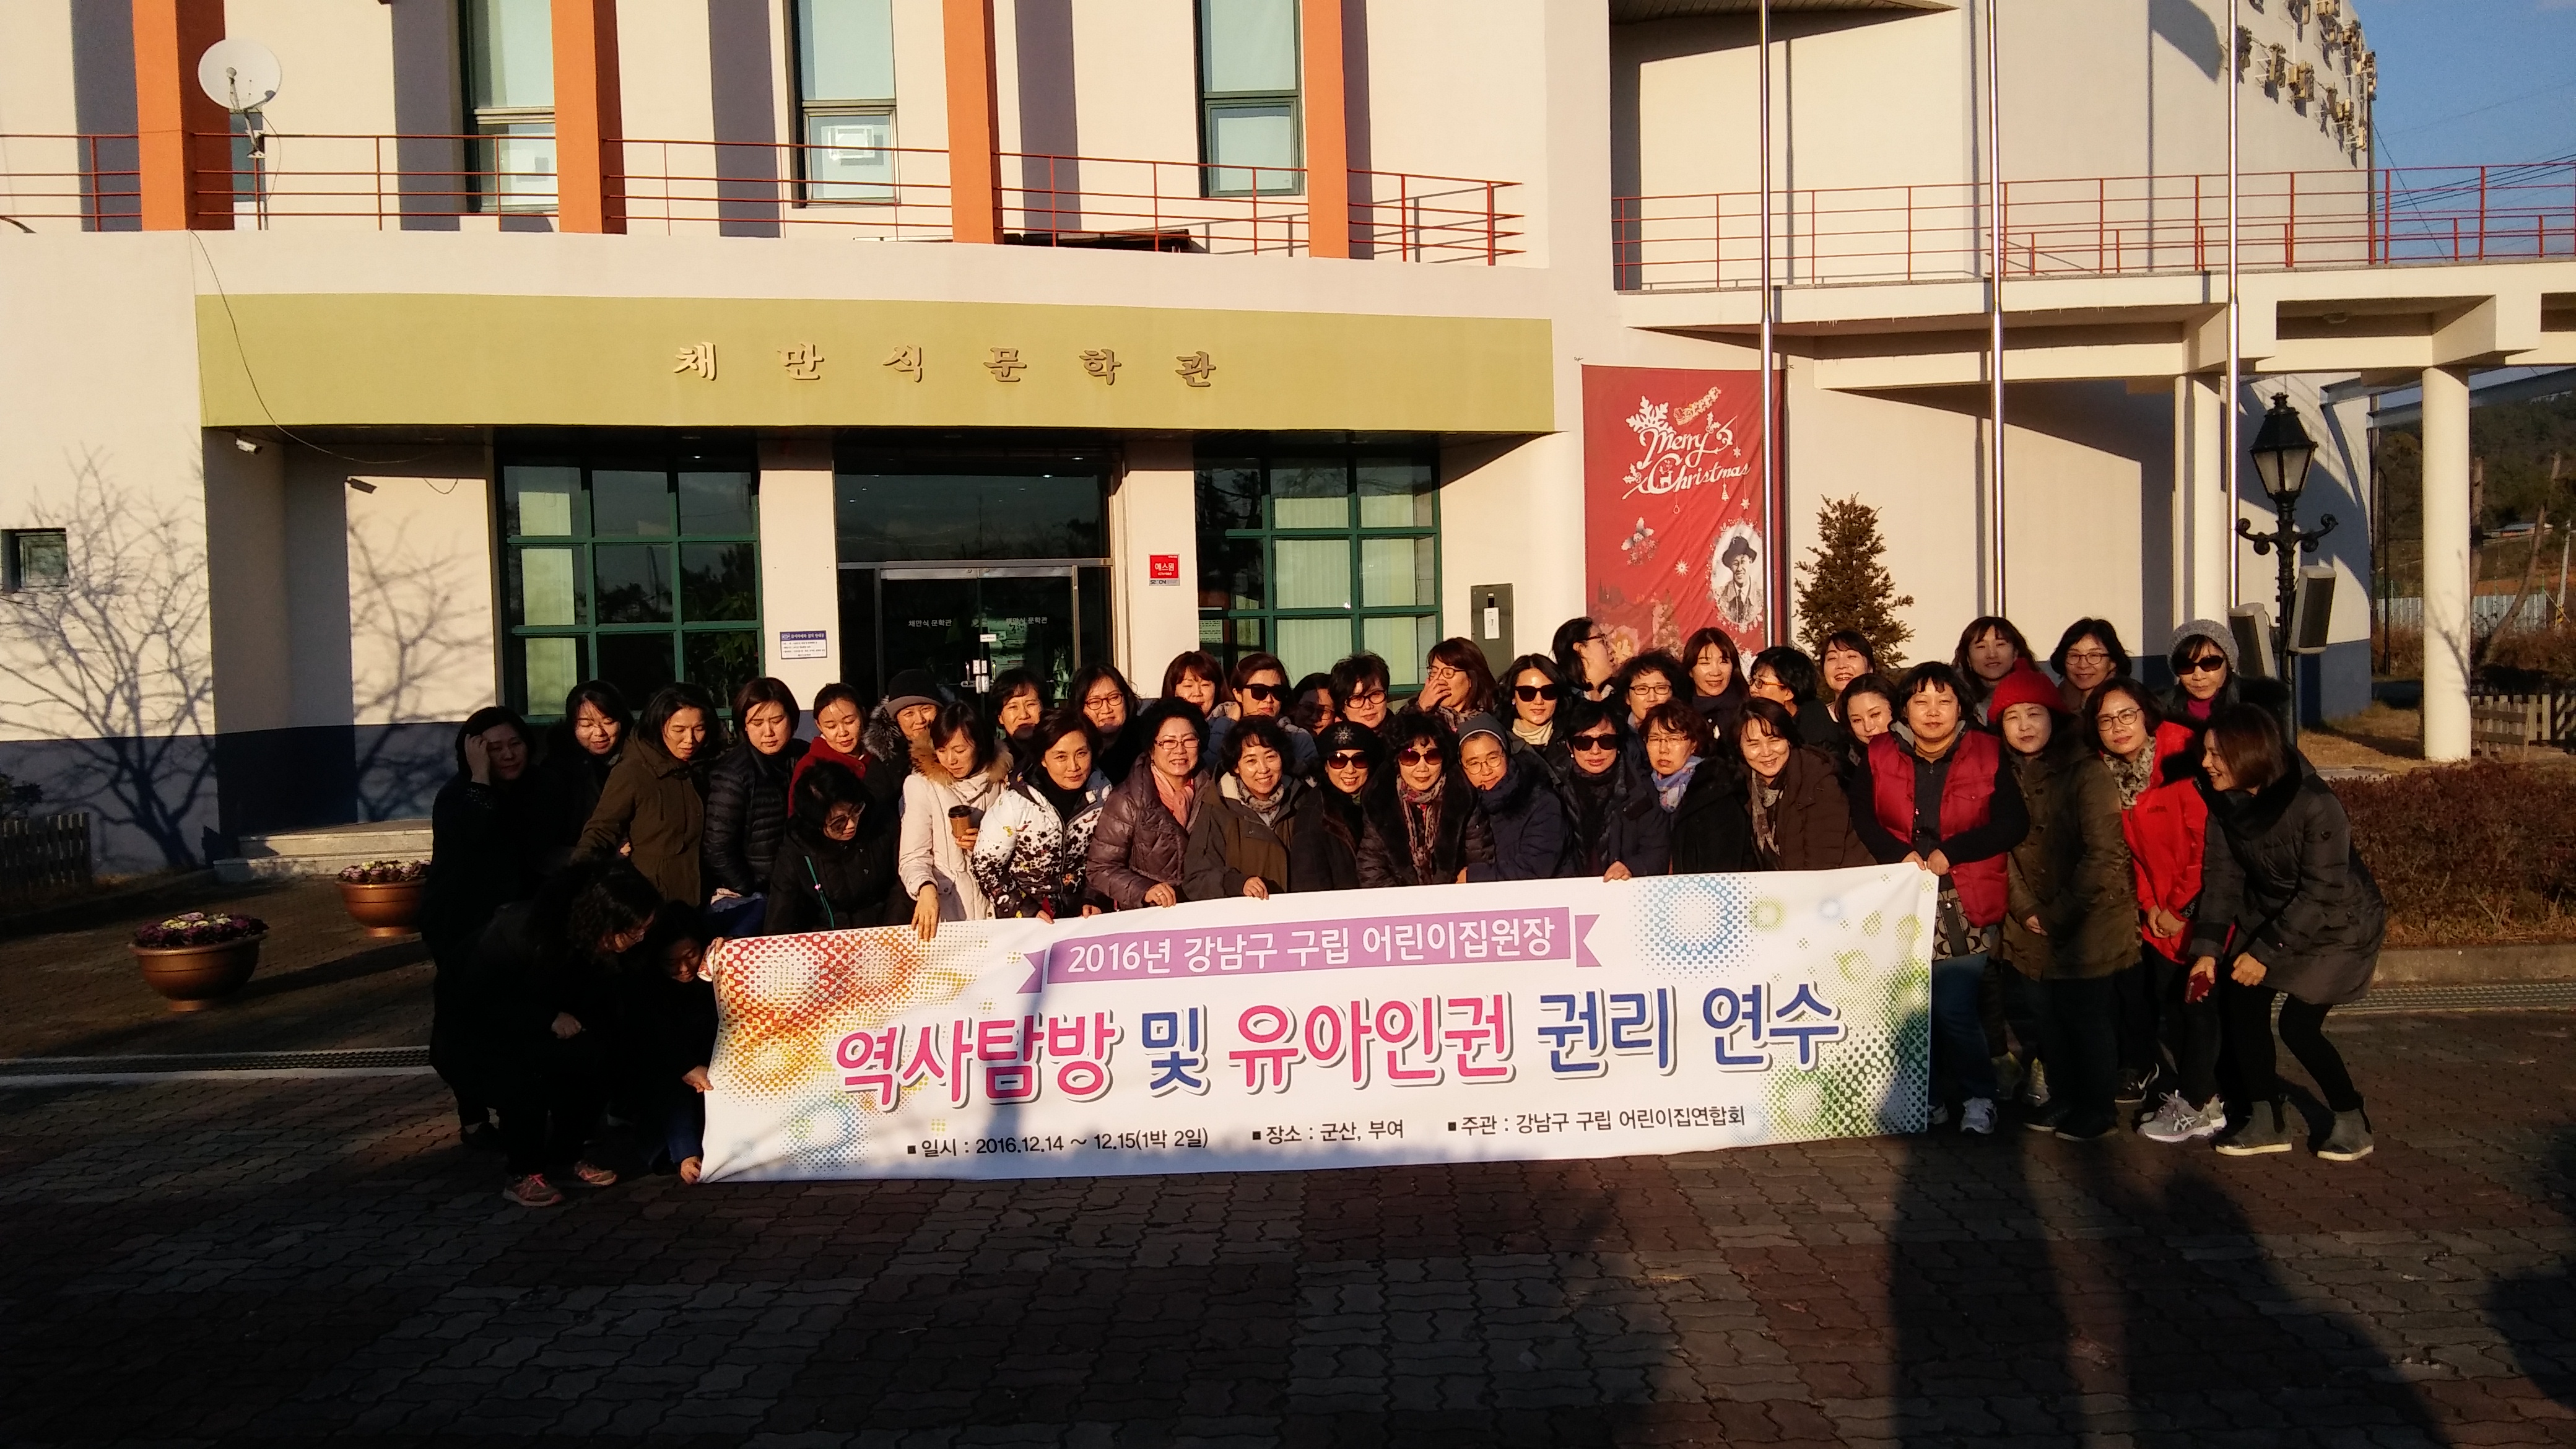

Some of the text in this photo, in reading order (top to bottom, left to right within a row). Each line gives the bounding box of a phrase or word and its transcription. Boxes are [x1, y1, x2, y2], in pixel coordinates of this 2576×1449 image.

[1637, 427, 1733, 469] Merry
[1622, 453, 1751, 500] Christmas
[1154, 562, 1175, 572] 에스원
[1068, 916, 1556, 974] 2016년 강남구 구립 어린이집원장
[836, 982, 1845, 1108] 역사탐방 및 유아인권 권리 연수
[1266, 1125, 1302, 1145] 장소
[1320, 1121, 1362, 1142] 군산,
[1368, 1119, 1403, 1140] 부여
[1461, 1115, 1497, 1136] 주관
[1516, 1112, 1570, 1134] 강남구
[1576, 1110, 1612, 1132] 구립
[1619, 1105, 1746, 1129] 어린이집연합회
[921, 1138, 957, 1157] 일시
[975, 1135, 1064, 1154] 2016.12.14
[1094, 1129, 1168, 1151] 12.15(1박
[1174, 1126, 1208, 1149] 2일)
